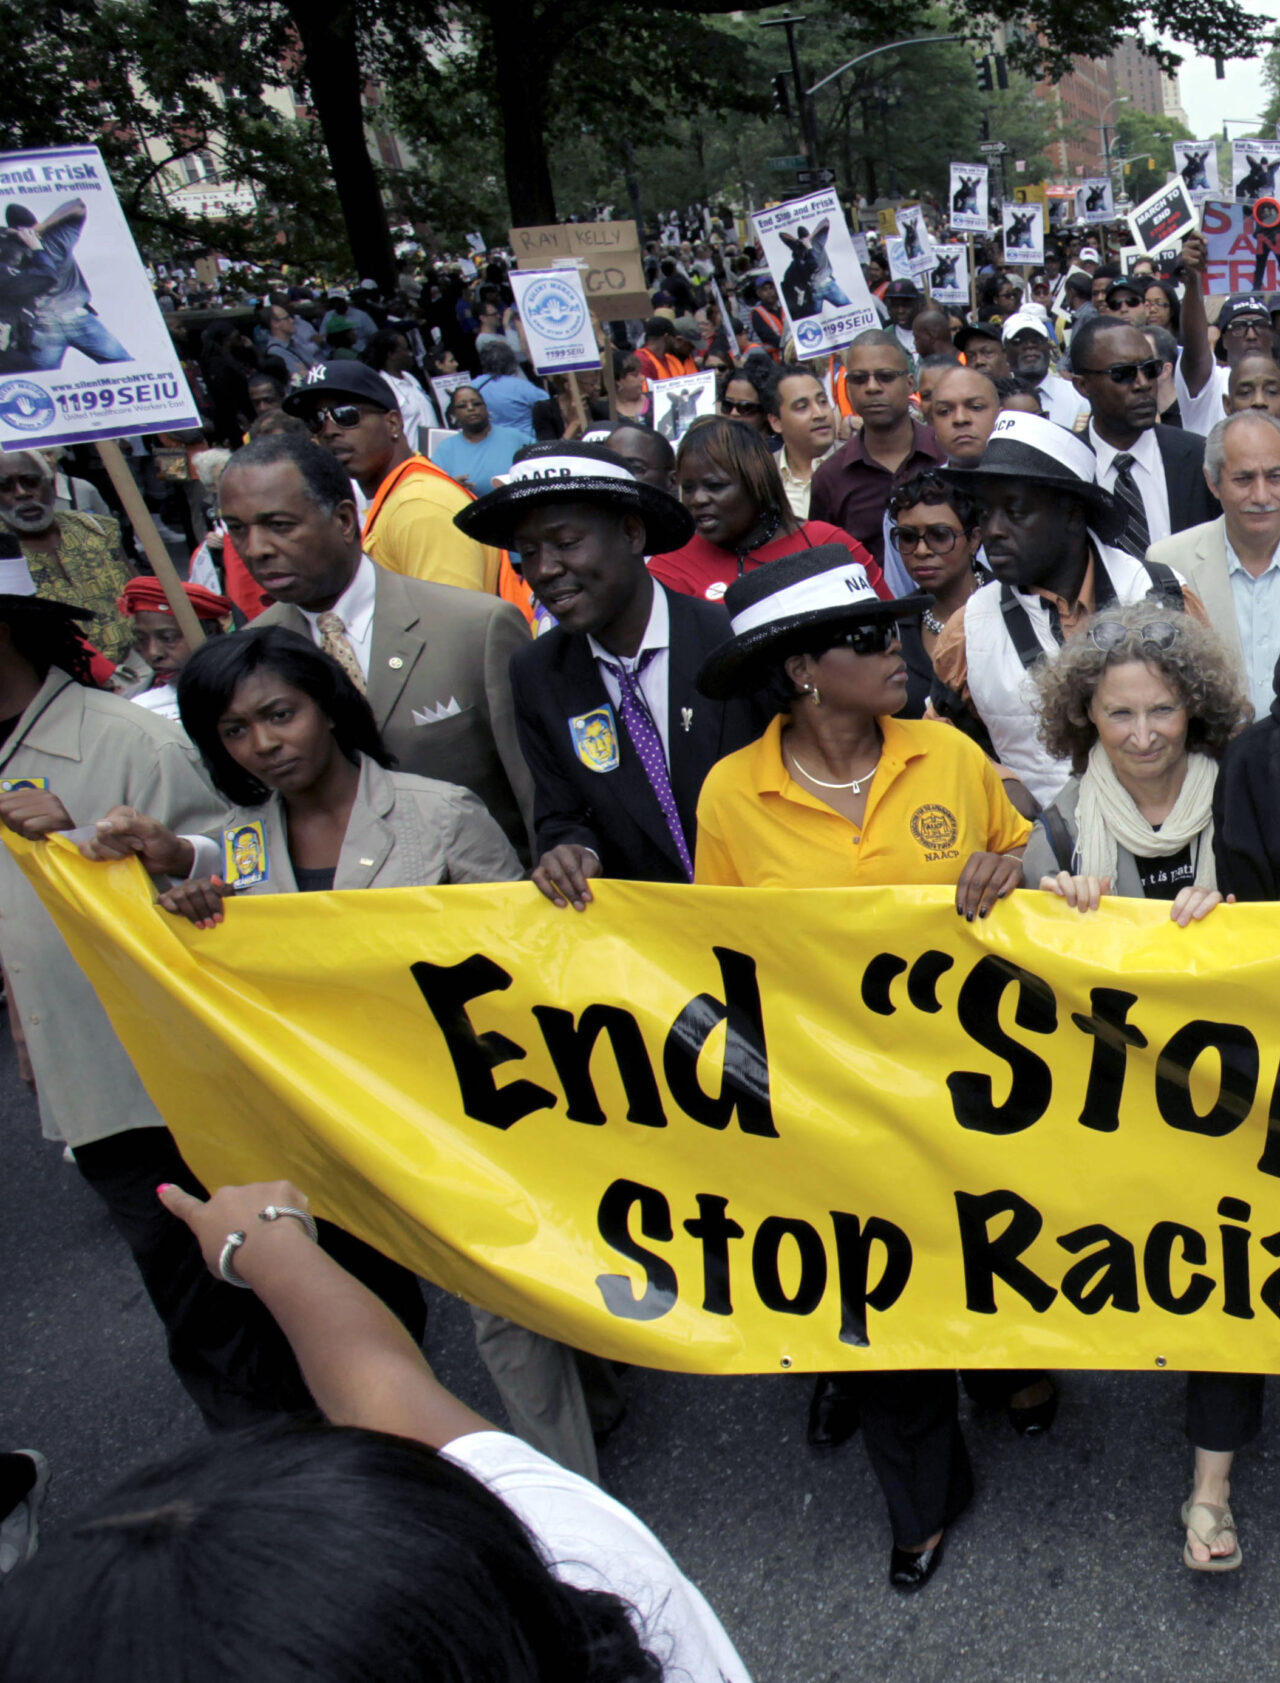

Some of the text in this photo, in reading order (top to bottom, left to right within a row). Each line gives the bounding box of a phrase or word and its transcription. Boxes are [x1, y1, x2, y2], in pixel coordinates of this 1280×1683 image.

[0, 163, 98, 184] and Frisk
[18, 184, 52, 194] Racial
[56, 181, 102, 193] Profiling
[758, 218, 774, 229] End
[794, 205, 809, 216] and
[811, 197, 835, 210] Frisk
[1136, 188, 1180, 226] MARCH TO
[1153, 207, 1171, 225] END
[520, 228, 620, 252] RAY KELLY
[1162, 250, 1175, 260] TO
[585, 267, 626, 292] GO
[51, 372, 175, 392] www.silentMarchNYC.org
[308, 363, 327, 384] NY
[56, 382, 179, 413] 1199SEIU
[63, 400, 186, 421] United Healthcare Workers East
[924, 850, 960, 863] NAACP
[1158, 870, 1168, 882] is
[410, 946, 780, 1138] End
[595, 1178, 913, 1347] Stop
